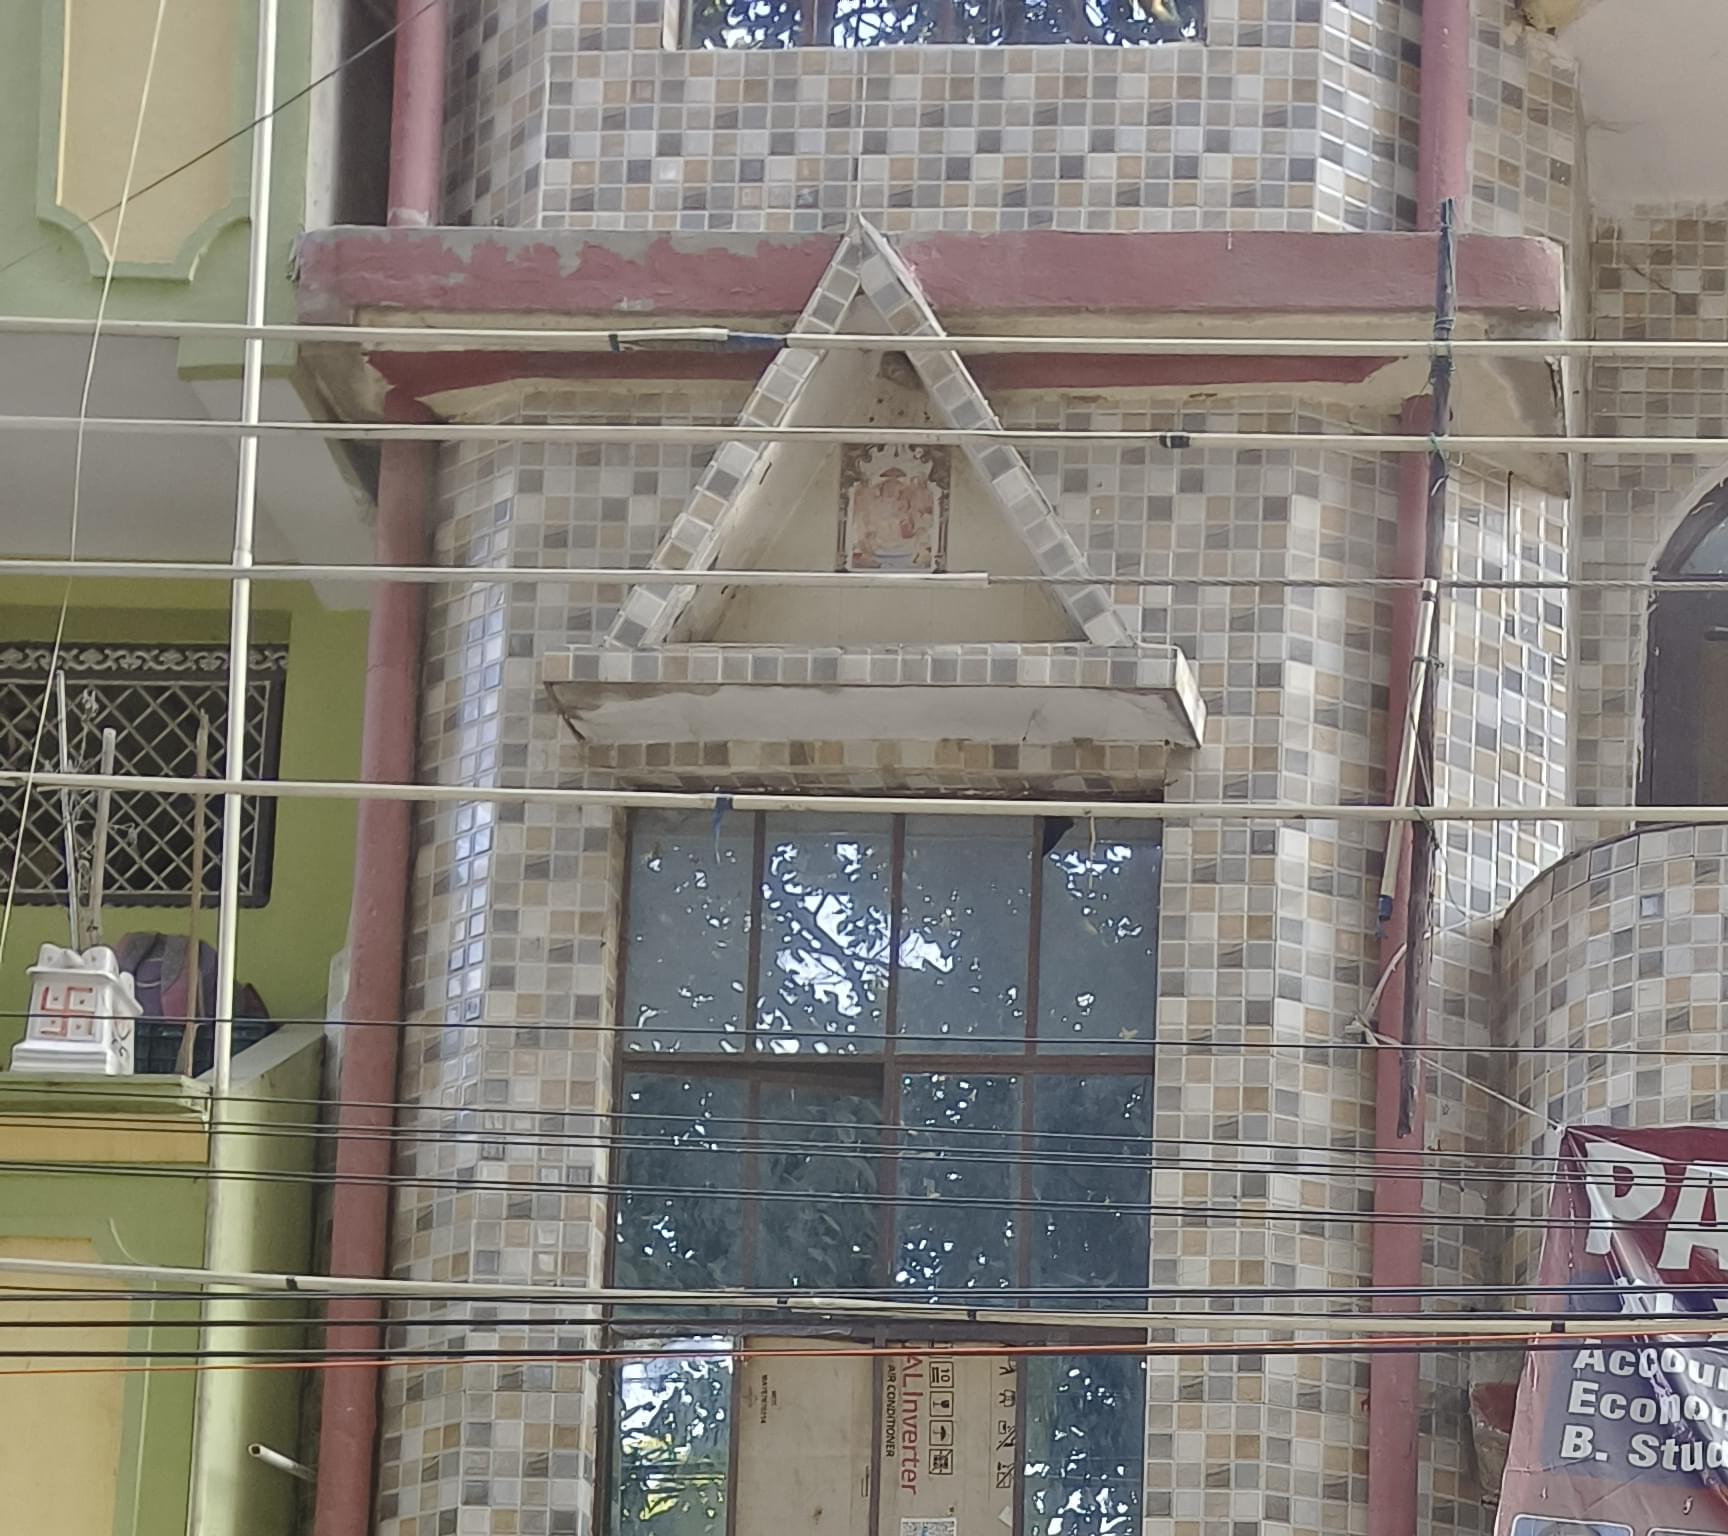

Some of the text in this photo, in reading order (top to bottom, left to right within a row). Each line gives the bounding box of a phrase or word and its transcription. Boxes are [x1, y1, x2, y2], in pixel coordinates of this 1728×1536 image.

[886, 1363, 897, 1458] AIR CONDITIONER
[901, 1391, 924, 1495] Inverter
[1561, 1425, 1608, 1461] B.
